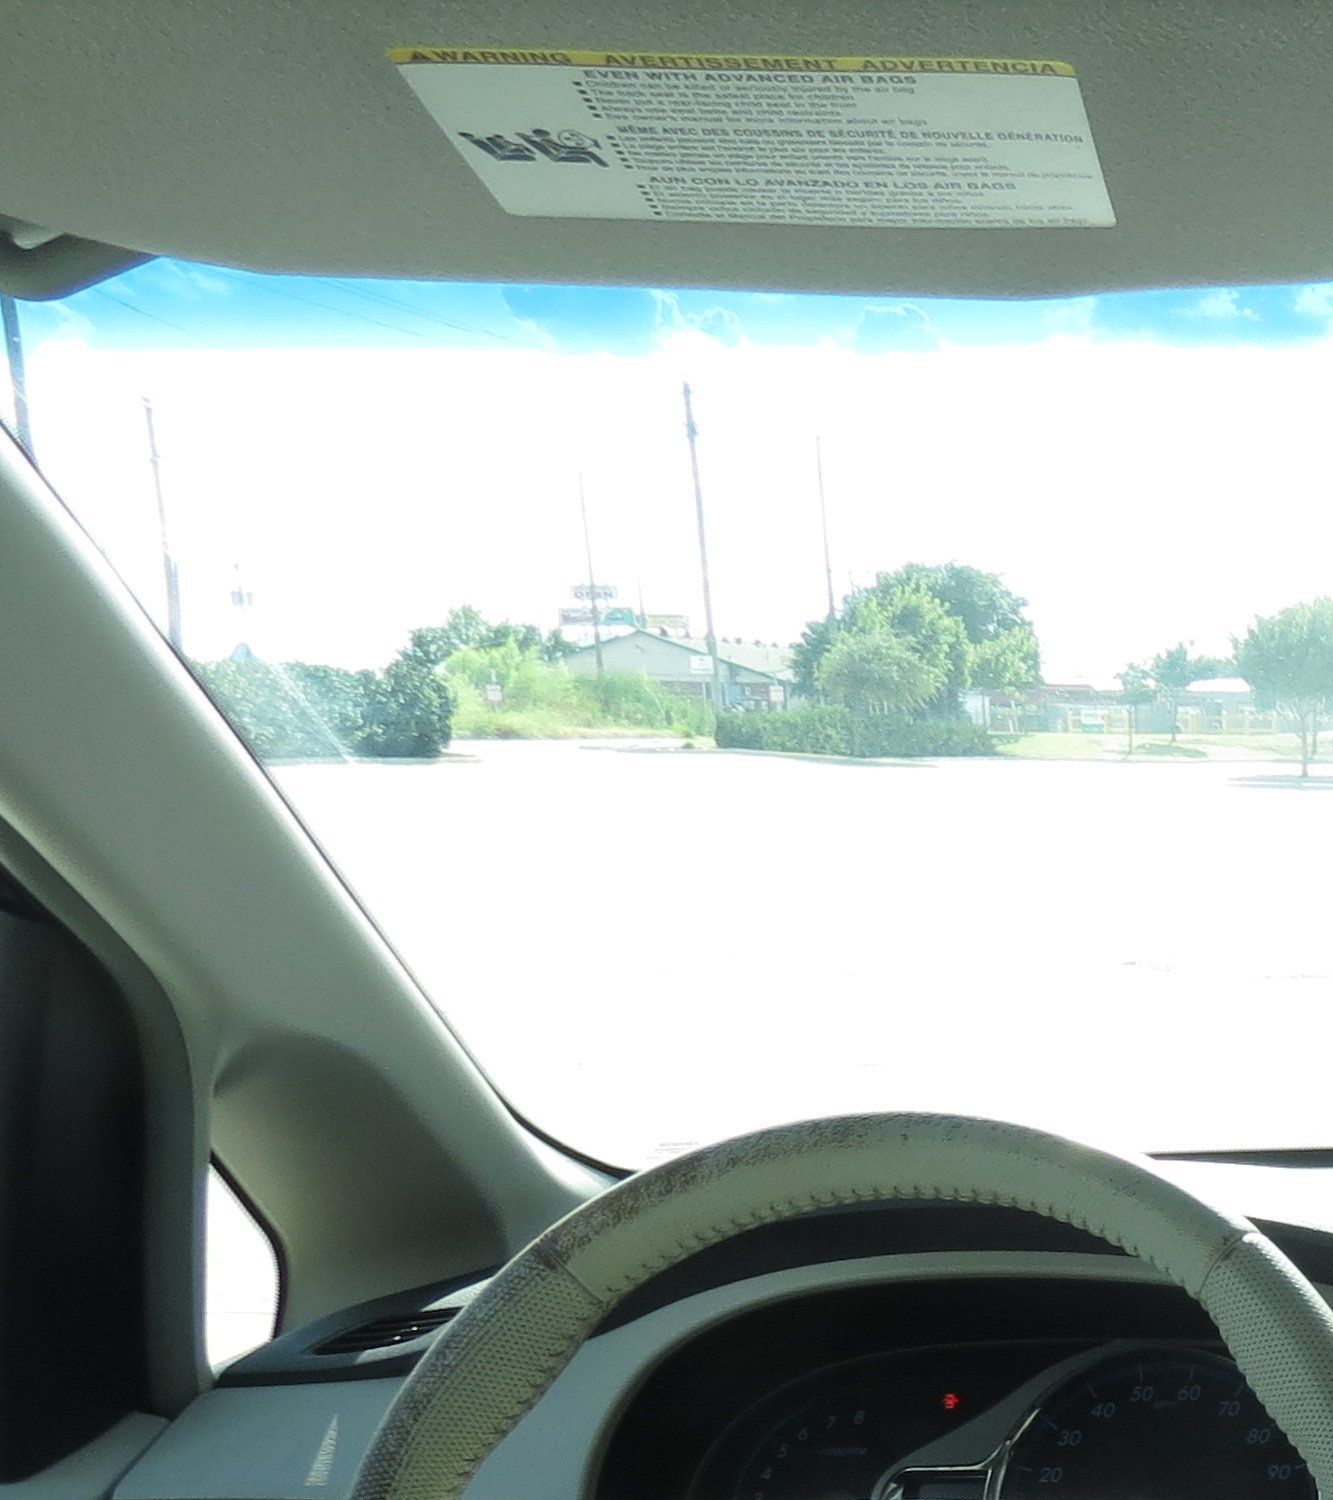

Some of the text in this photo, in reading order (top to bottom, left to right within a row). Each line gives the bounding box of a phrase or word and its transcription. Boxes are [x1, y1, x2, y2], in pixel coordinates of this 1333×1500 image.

[430, 50, 1057, 76] WARNING AVERTISSEMENT ADVERTENCIA
[582, 70, 917, 85] EVEN WITH ADVANCED AIR BAGS
[1130, 1385, 1154, 1402] 50
[1177, 1384, 1201, 1401] 60
[1091, 1401, 1116, 1419] 40
[1218, 1400, 1241, 1417] 70
[826, 1415, 838, 1431] 7
[853, 1410, 866, 1425] 8
[1056, 1429, 1082, 1447] 30
[1246, 1427, 1272, 1444] 80
[1038, 1466, 1063, 1484] 20
[1267, 1464, 1292, 1481] 90
